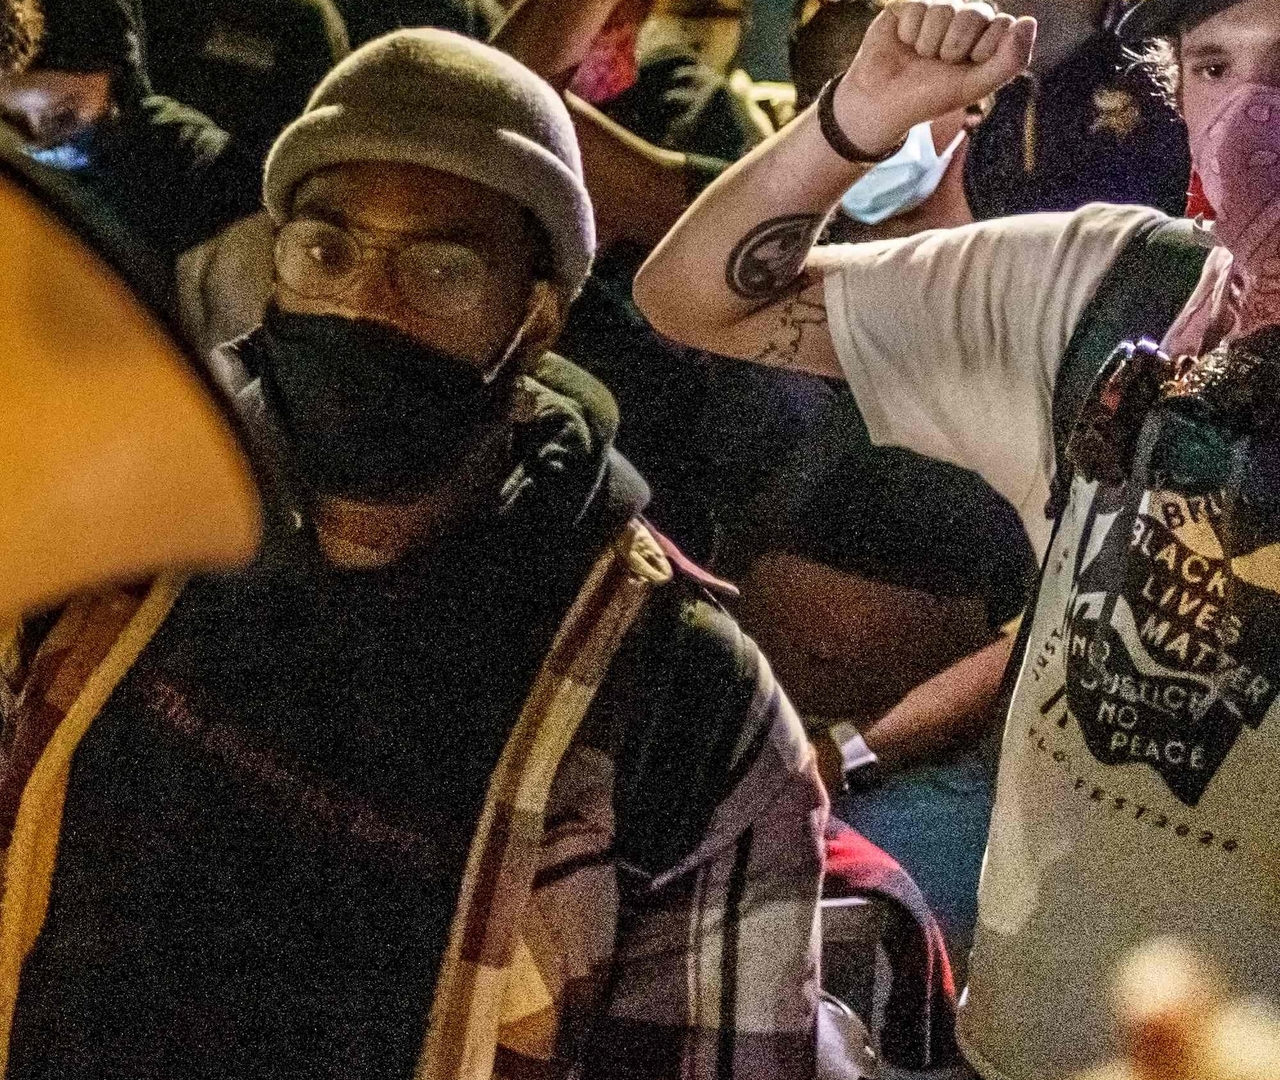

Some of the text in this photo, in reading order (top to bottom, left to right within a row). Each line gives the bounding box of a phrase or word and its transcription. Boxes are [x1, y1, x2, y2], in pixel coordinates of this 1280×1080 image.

[1130, 520, 1227, 598] BLACK
[1142, 576, 1243, 644] LIVES
[1071, 633, 1111, 669] NO
[1143, 622, 1270, 703] MATTER
[1097, 700, 1139, 730] NO
[1110, 730, 1206, 770] PEACE
